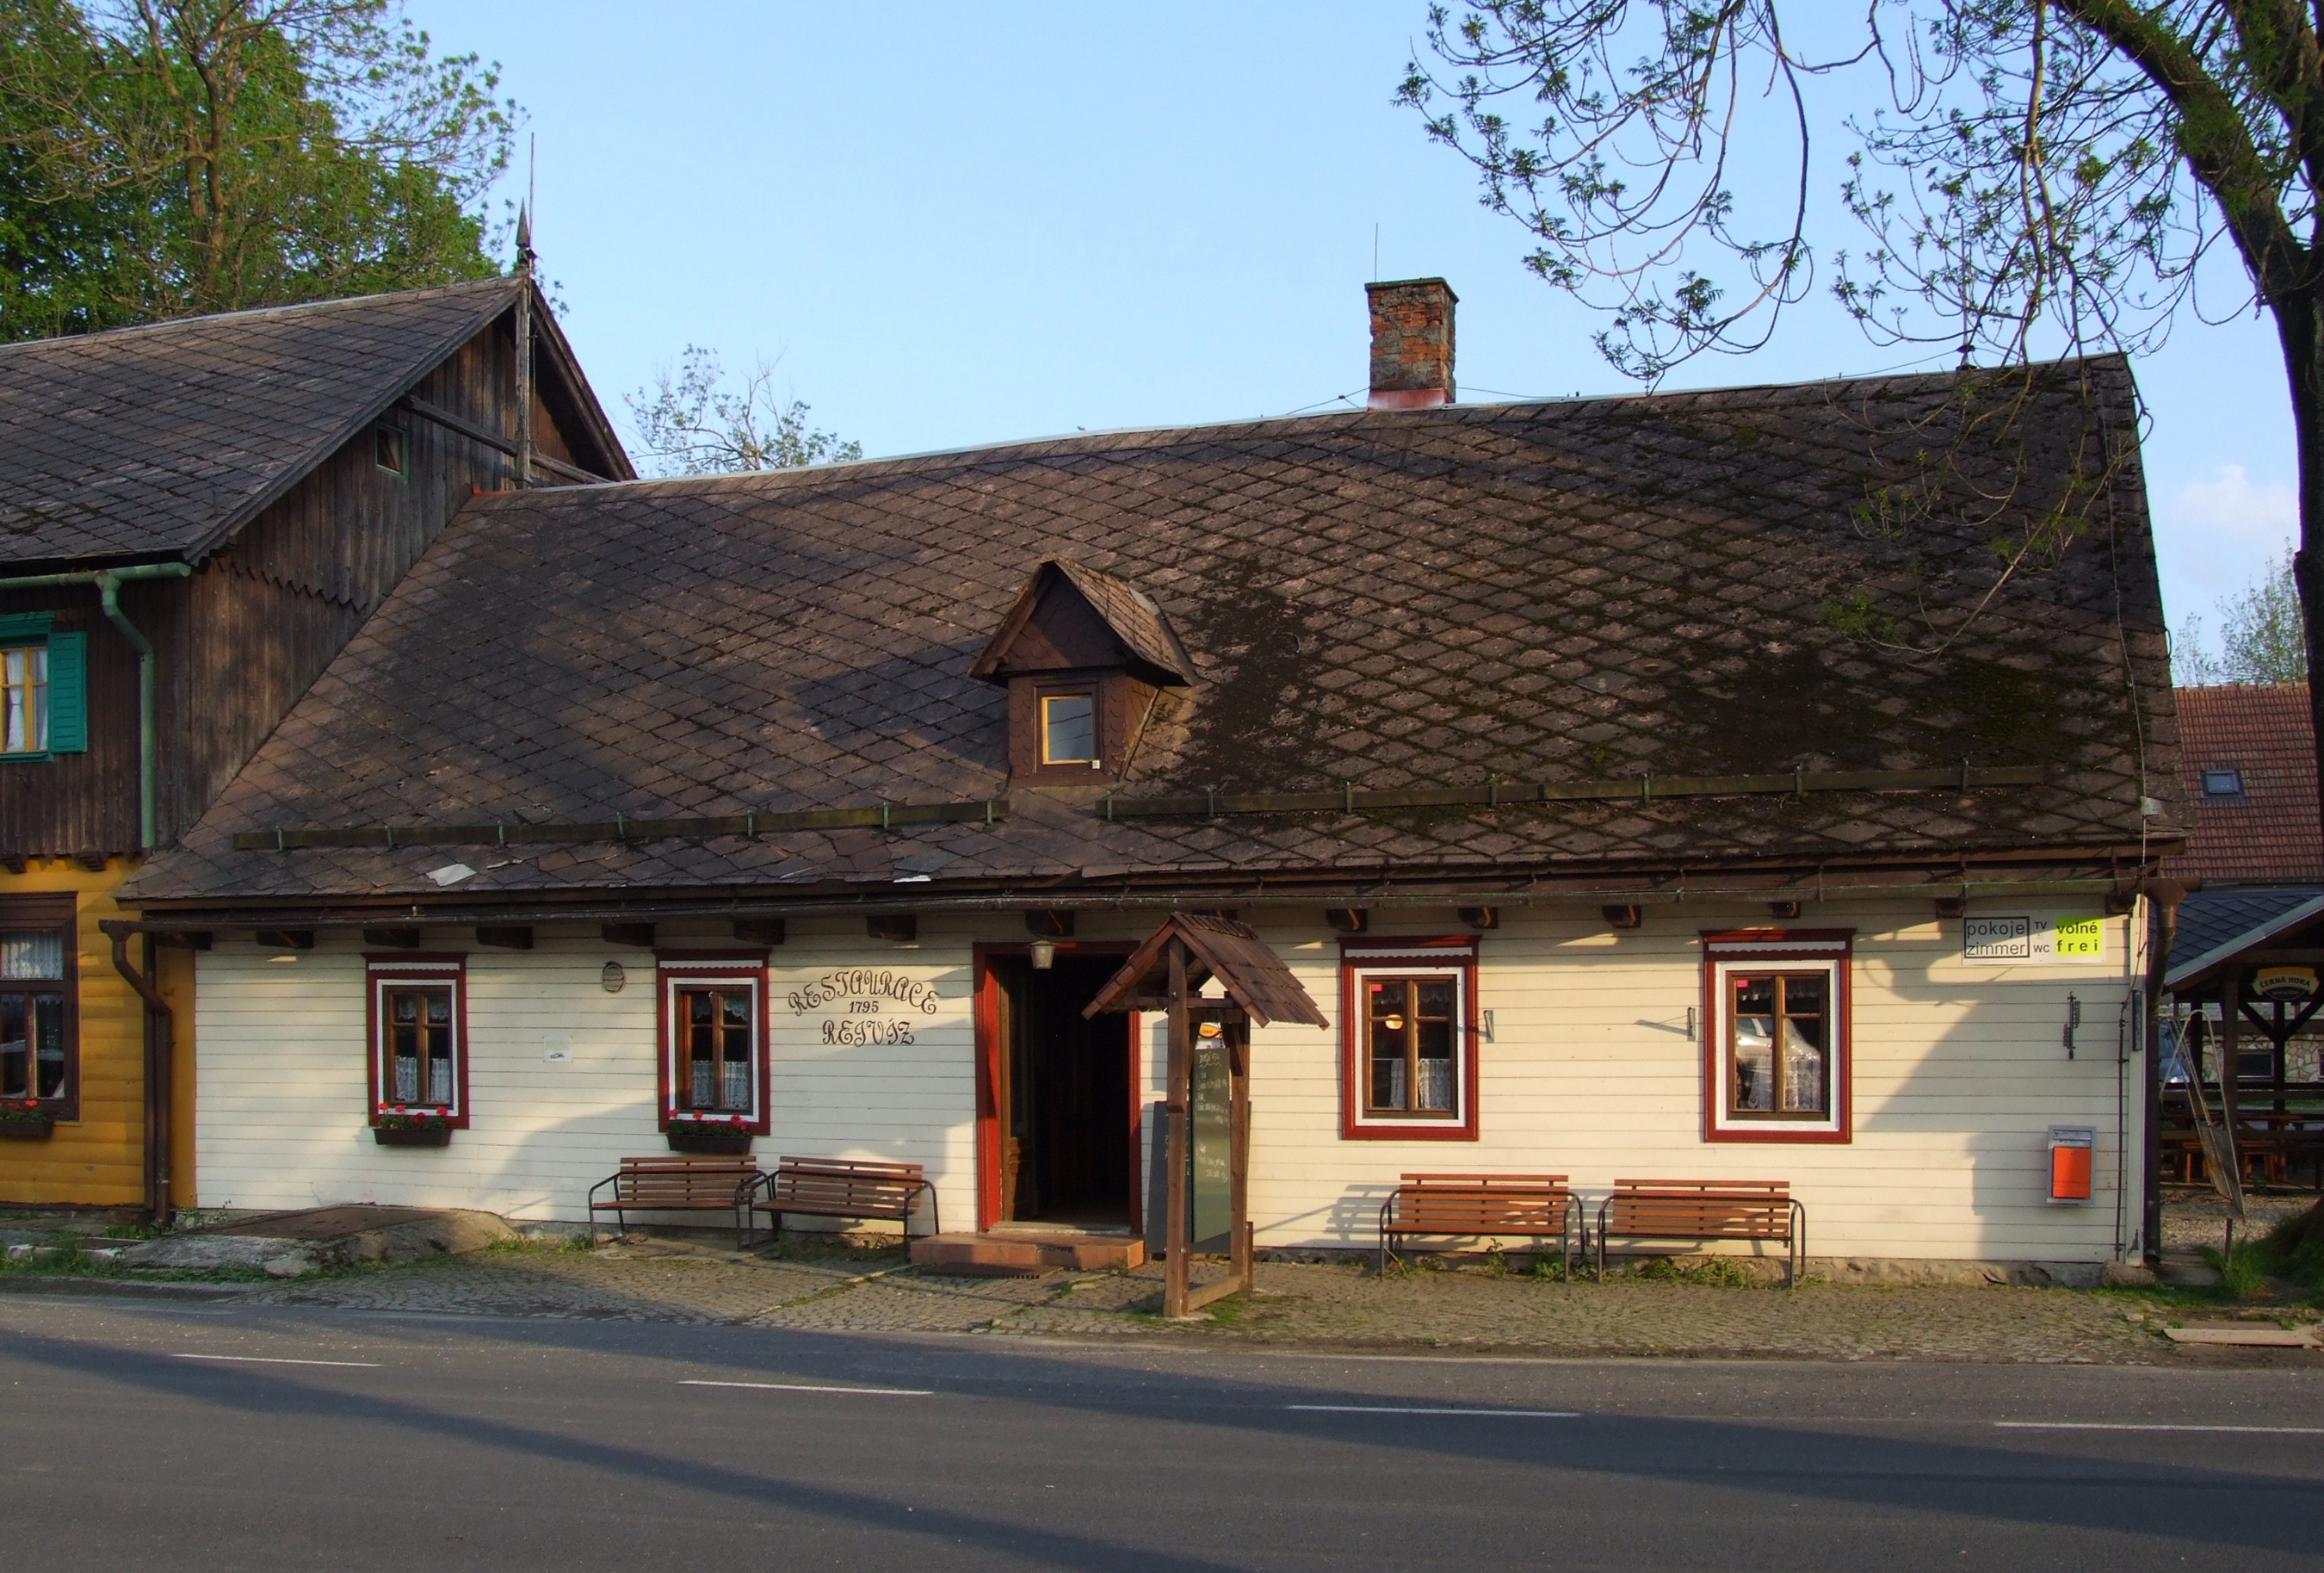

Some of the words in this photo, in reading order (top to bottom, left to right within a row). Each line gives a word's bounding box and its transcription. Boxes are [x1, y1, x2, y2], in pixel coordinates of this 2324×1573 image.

[1967, 920, 2024, 938] pokoje
[2056, 922, 2098, 934] volné
[1967, 943, 2025, 955] zimmer
[2056, 939, 2098, 952] frei
[2288, 976, 2310, 987] HORA
[788, 969, 940, 1016] RESTAURACE
[849, 1000, 879, 1013] 1795
[822, 1018, 914, 1047] REJVÍZ
